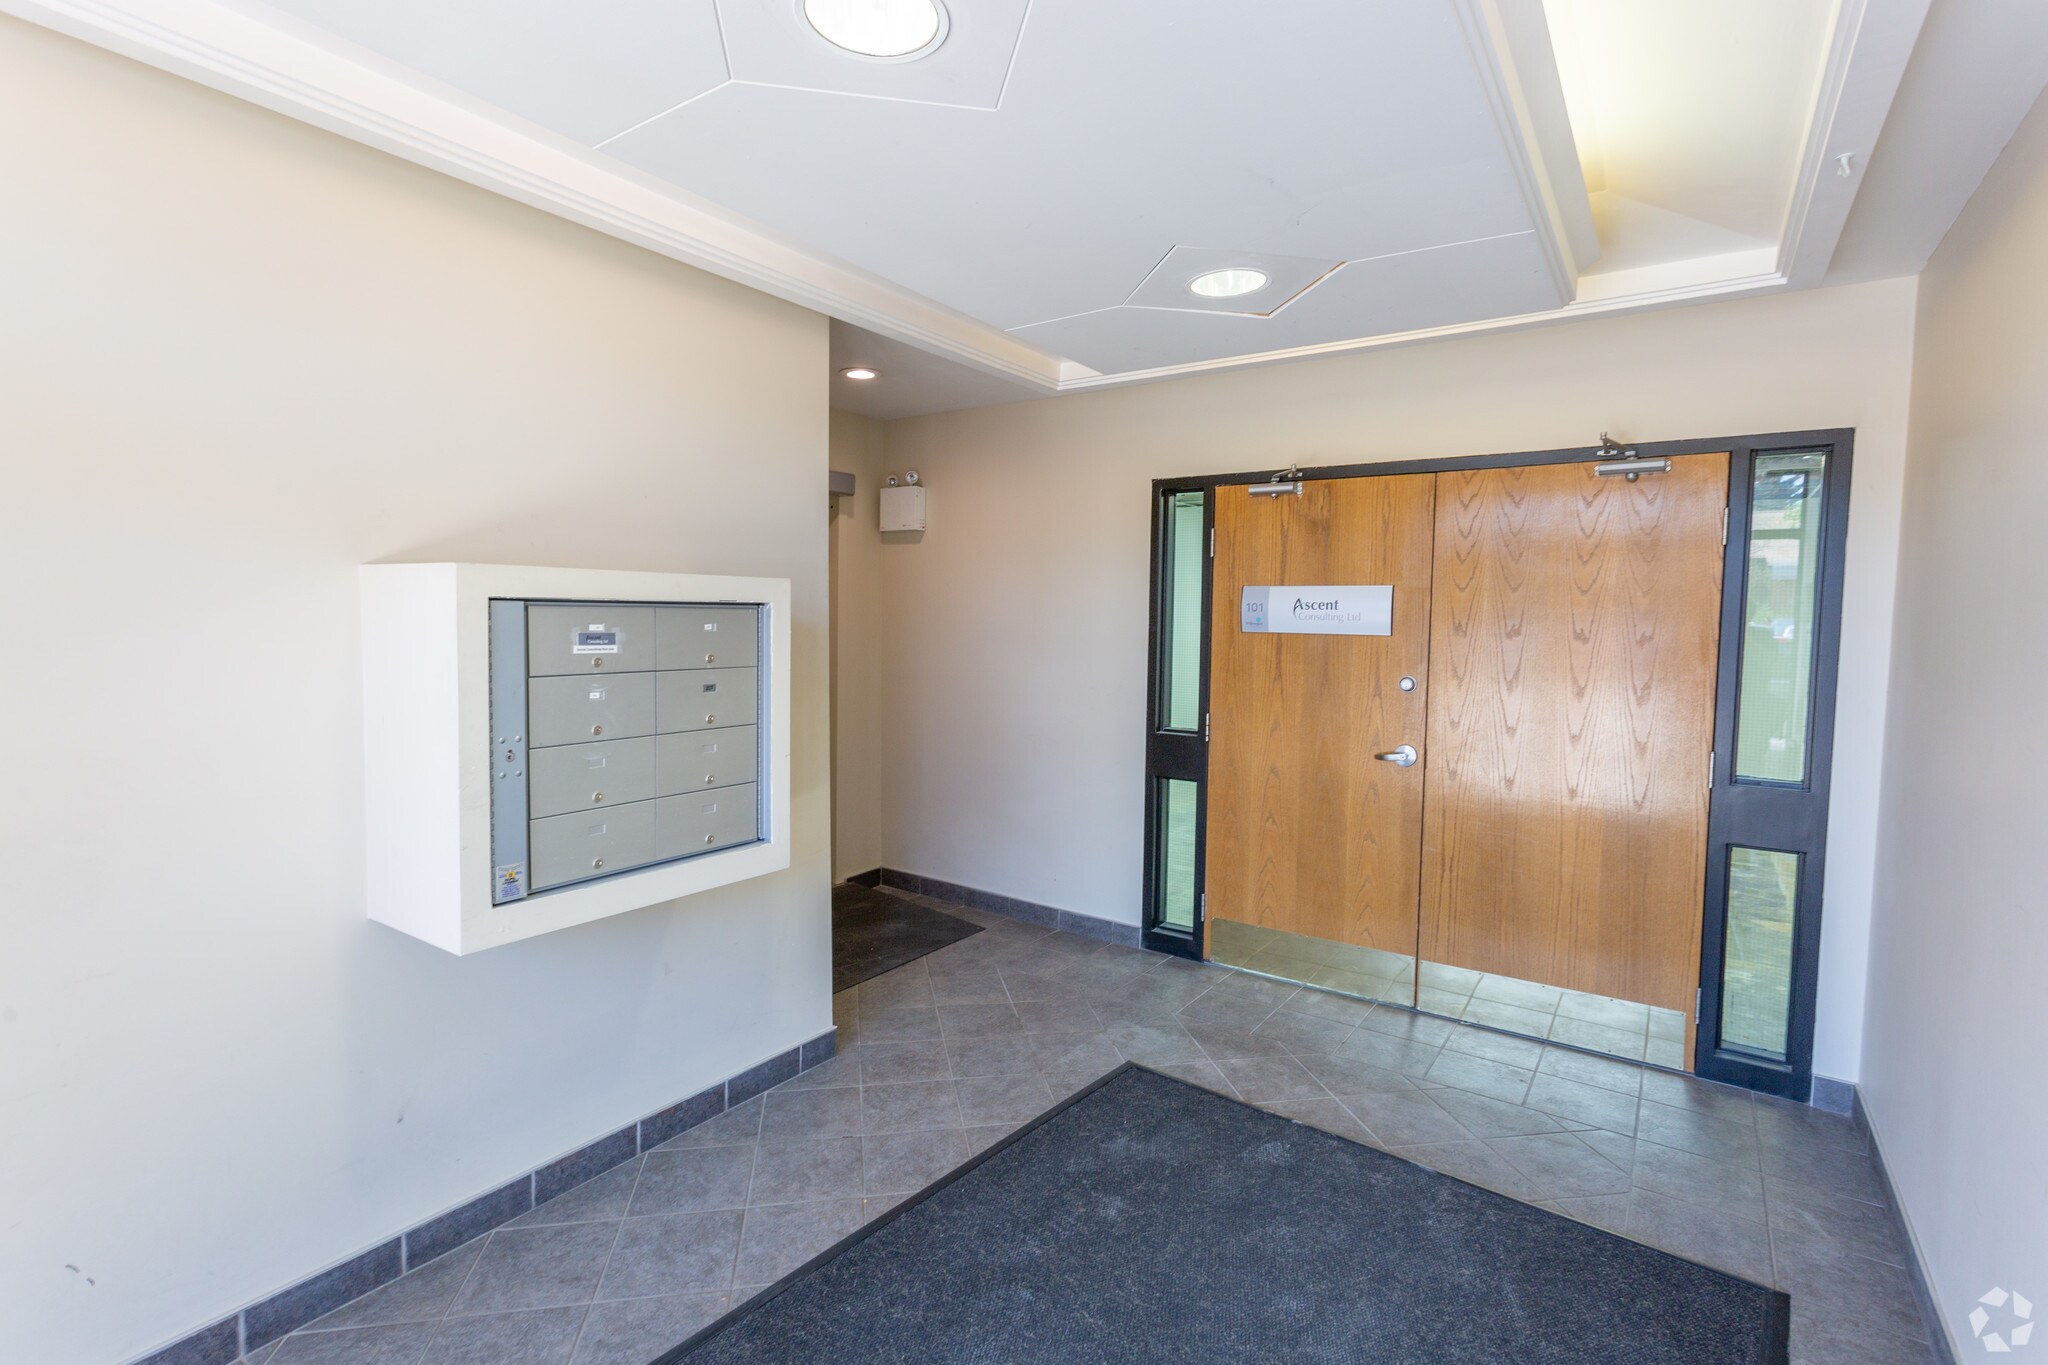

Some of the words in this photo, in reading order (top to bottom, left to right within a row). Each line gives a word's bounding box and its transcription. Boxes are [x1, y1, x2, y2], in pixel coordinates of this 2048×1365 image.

[1245, 602, 1264, 612] 101
[1293, 598, 1339, 612] Ascent
[1298, 612, 1344, 623] Consulting
[1347, 612, 1361, 622] Ltd
